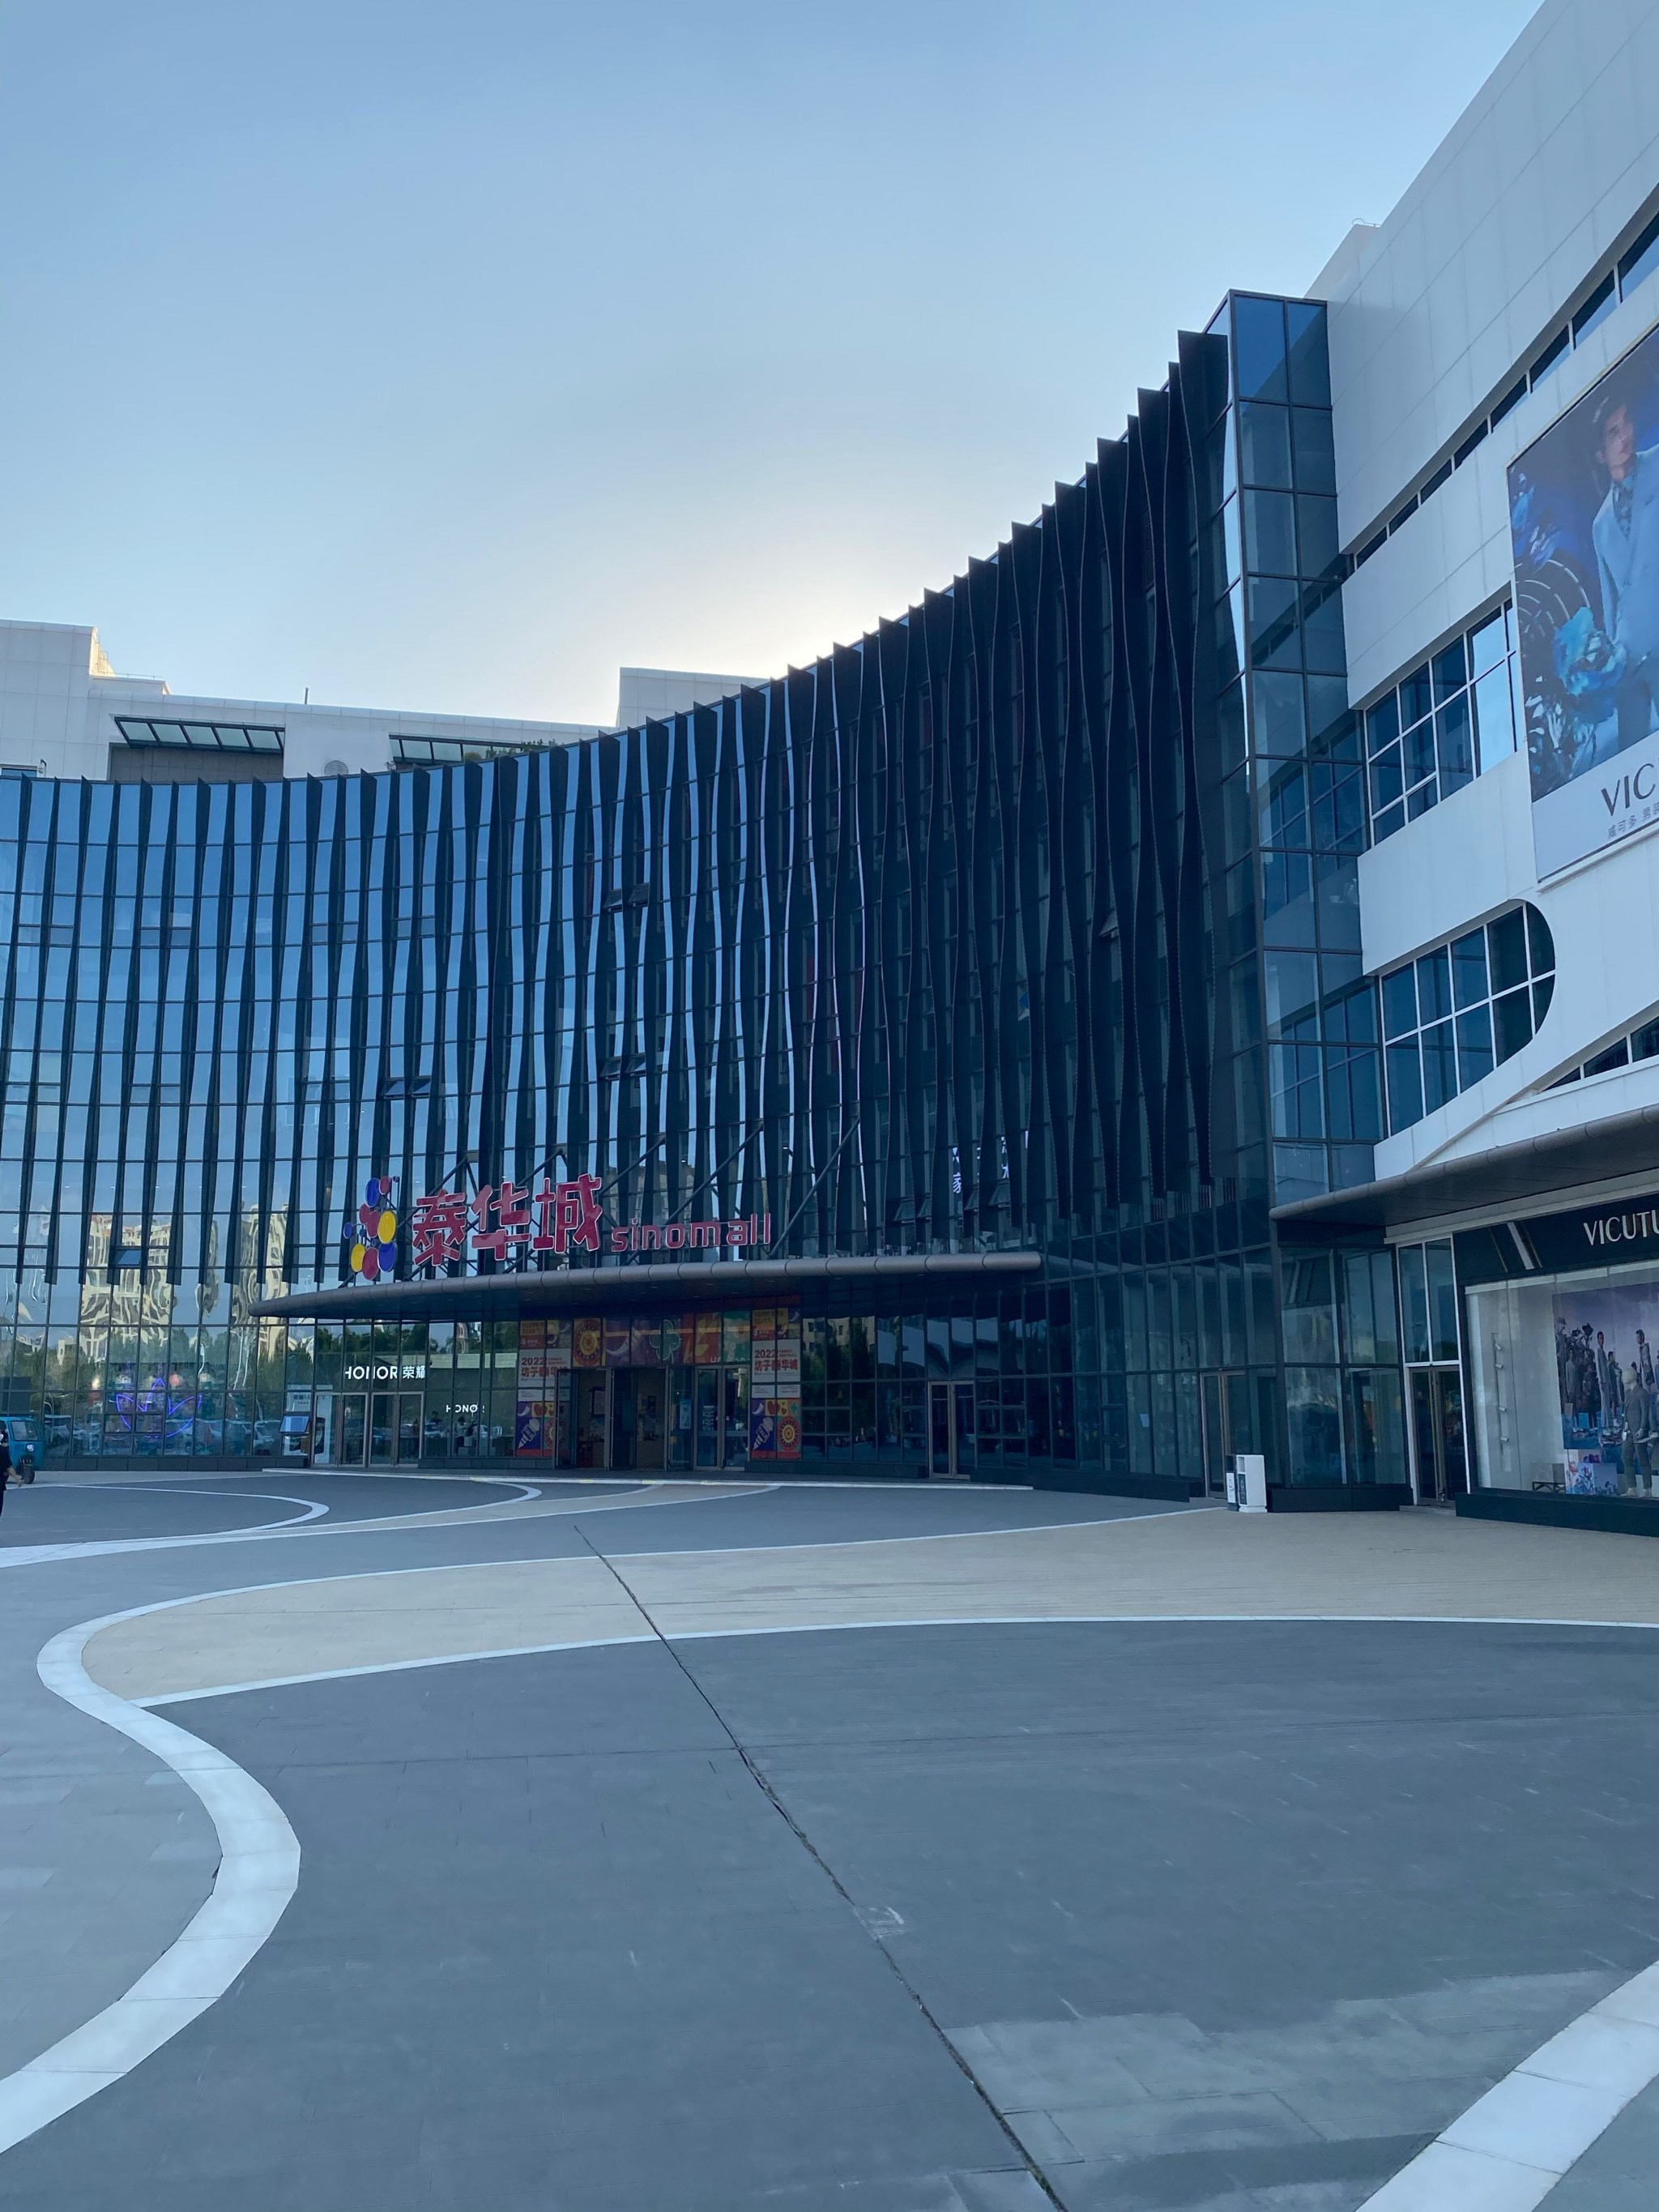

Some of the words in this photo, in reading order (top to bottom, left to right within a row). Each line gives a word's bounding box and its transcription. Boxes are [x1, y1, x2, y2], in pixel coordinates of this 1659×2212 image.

[412, 1173, 603, 1266] 泰华城
[611, 1212, 771, 1252] sinomall
[754, 1349, 778, 1358] 2022
[521, 1356, 547, 1366] 2022
[402, 1364, 426, 1379] 荣耀
[446, 1404, 485, 1413] HONO
